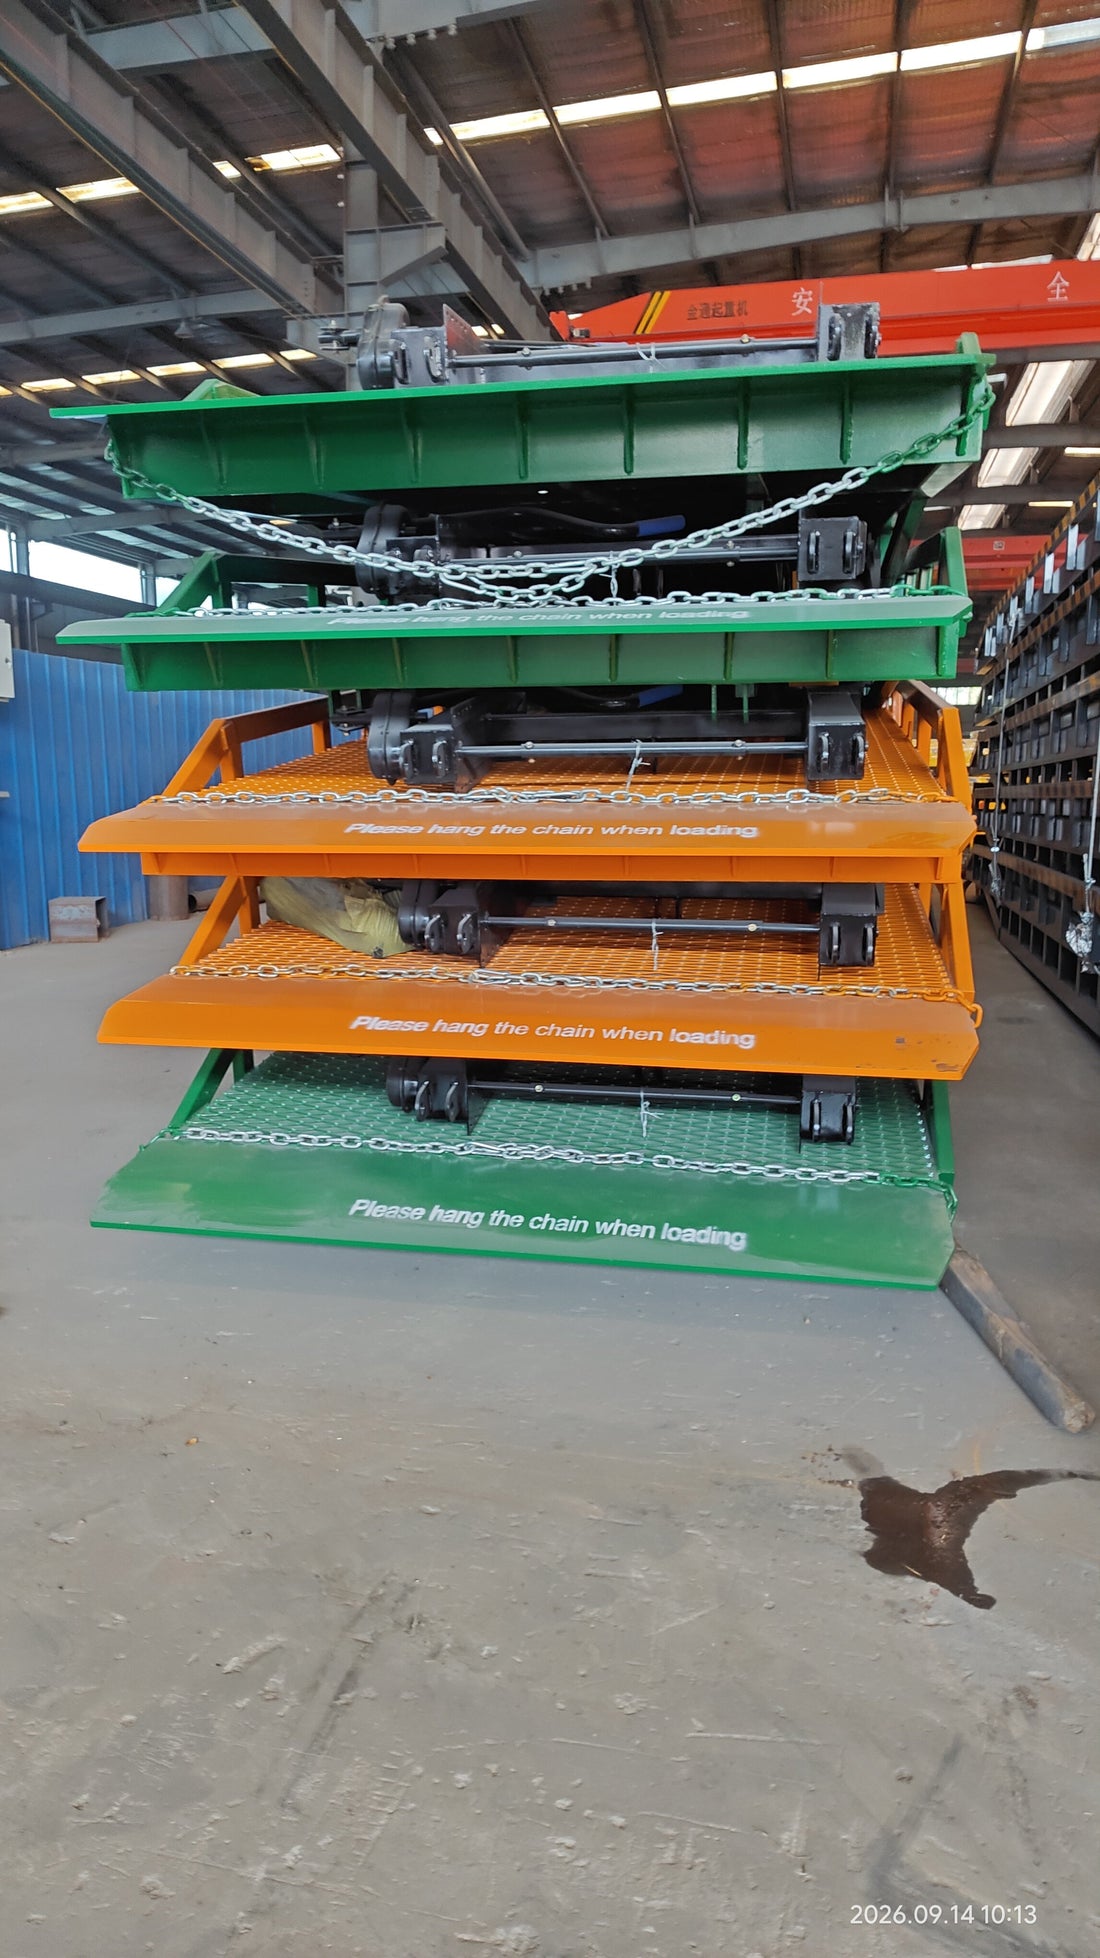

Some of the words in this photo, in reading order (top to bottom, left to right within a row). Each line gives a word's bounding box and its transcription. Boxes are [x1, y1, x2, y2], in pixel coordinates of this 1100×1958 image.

[791, 287, 813, 317] 安
[1046, 270, 1070, 303] 全
[328, 617, 409, 625] Please
[411, 616, 472, 624] hang
[476, 614, 513, 622] the
[519, 612, 582, 621] chain
[589, 611, 652, 620] when
[659, 610, 750, 619] loading
[344, 823, 424, 834] Please
[427, 824, 487, 837] hang
[490, 824, 527, 835] the
[532, 824, 594, 836] chain
[601, 825, 663, 836] when
[669, 824, 759, 838] loading
[349, 1015, 429, 1033] Please
[432, 1019, 489, 1037] hang
[493, 1021, 529, 1036] the
[535, 1022, 595, 1039] chain
[602, 1026, 664, 1042] when
[669, 1028, 756, 1050] loading
[348, 1199, 426, 1220] Please
[428, 1204, 485, 1229] hang
[489, 1209, 525, 1228] the
[529, 1213, 589, 1233] chain
[595, 1218, 656, 1239] when
[660, 1222, 748, 1252] loading
